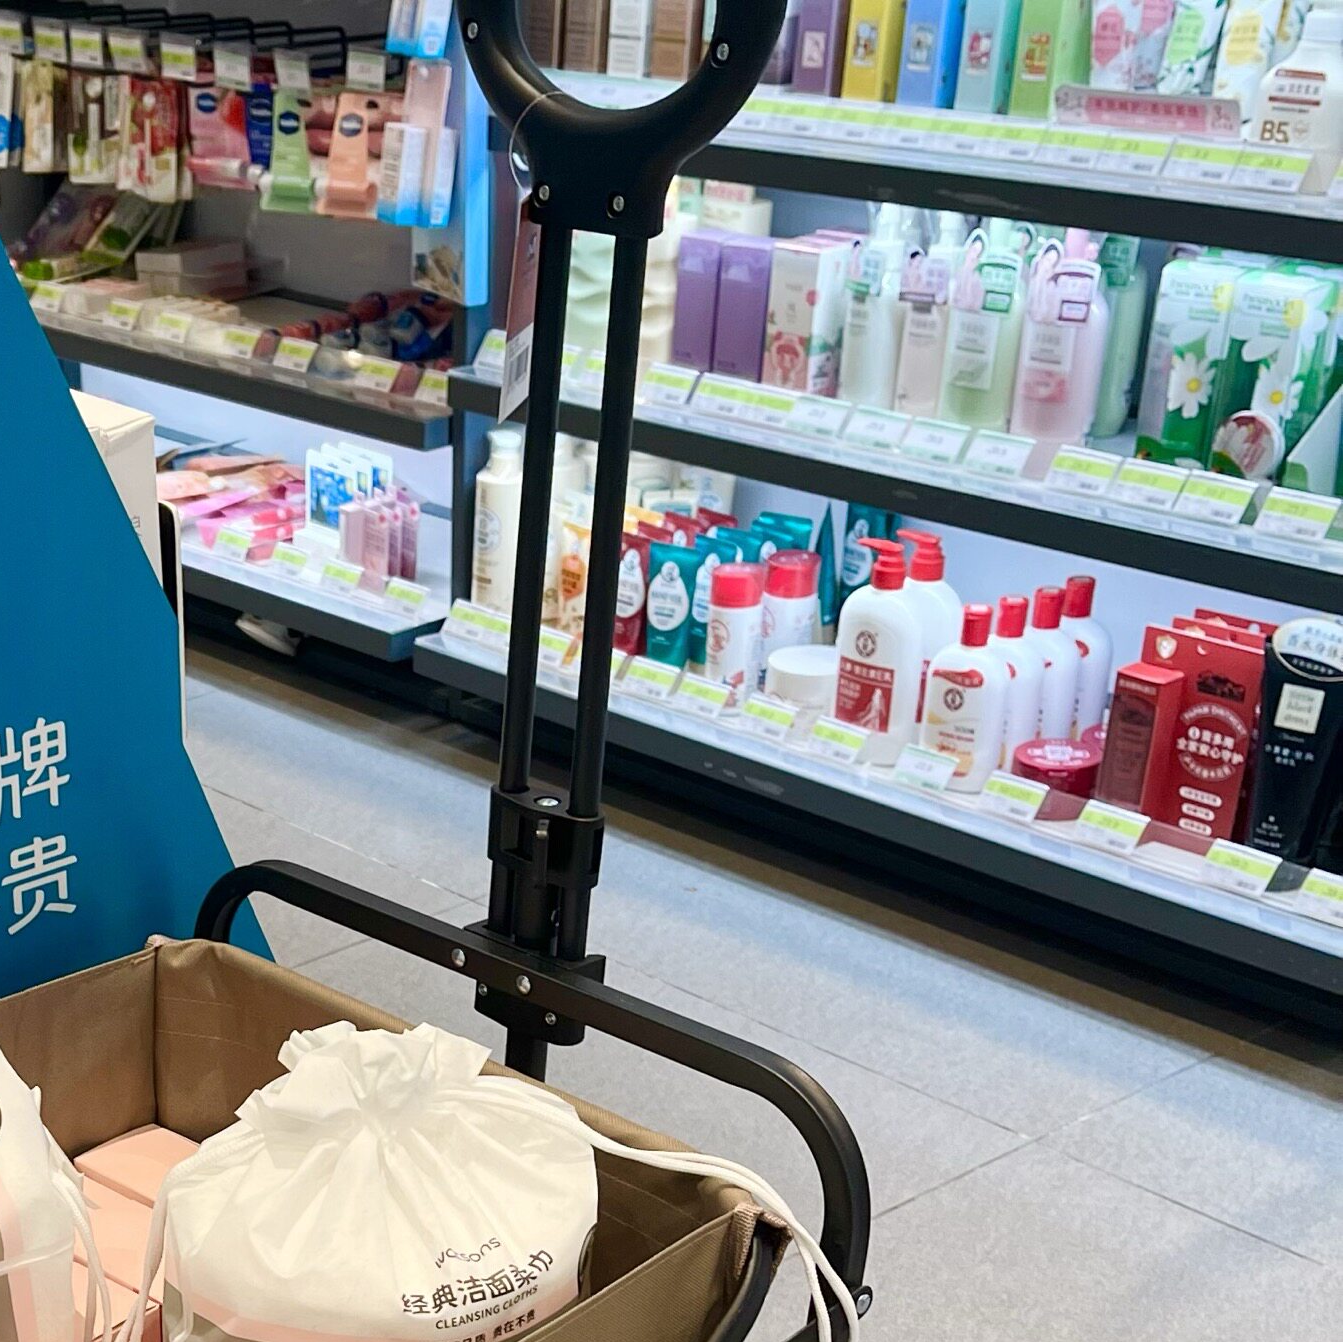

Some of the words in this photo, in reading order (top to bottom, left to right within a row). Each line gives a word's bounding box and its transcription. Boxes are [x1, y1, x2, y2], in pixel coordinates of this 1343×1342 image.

[401, 1249, 554, 1315] 经典洁面柔巾
[435, 1304, 500, 1330] CLEANSING
[502, 1284, 539, 1311] CLOTHS
[493, 1308, 536, 1339] 贵在不贵
